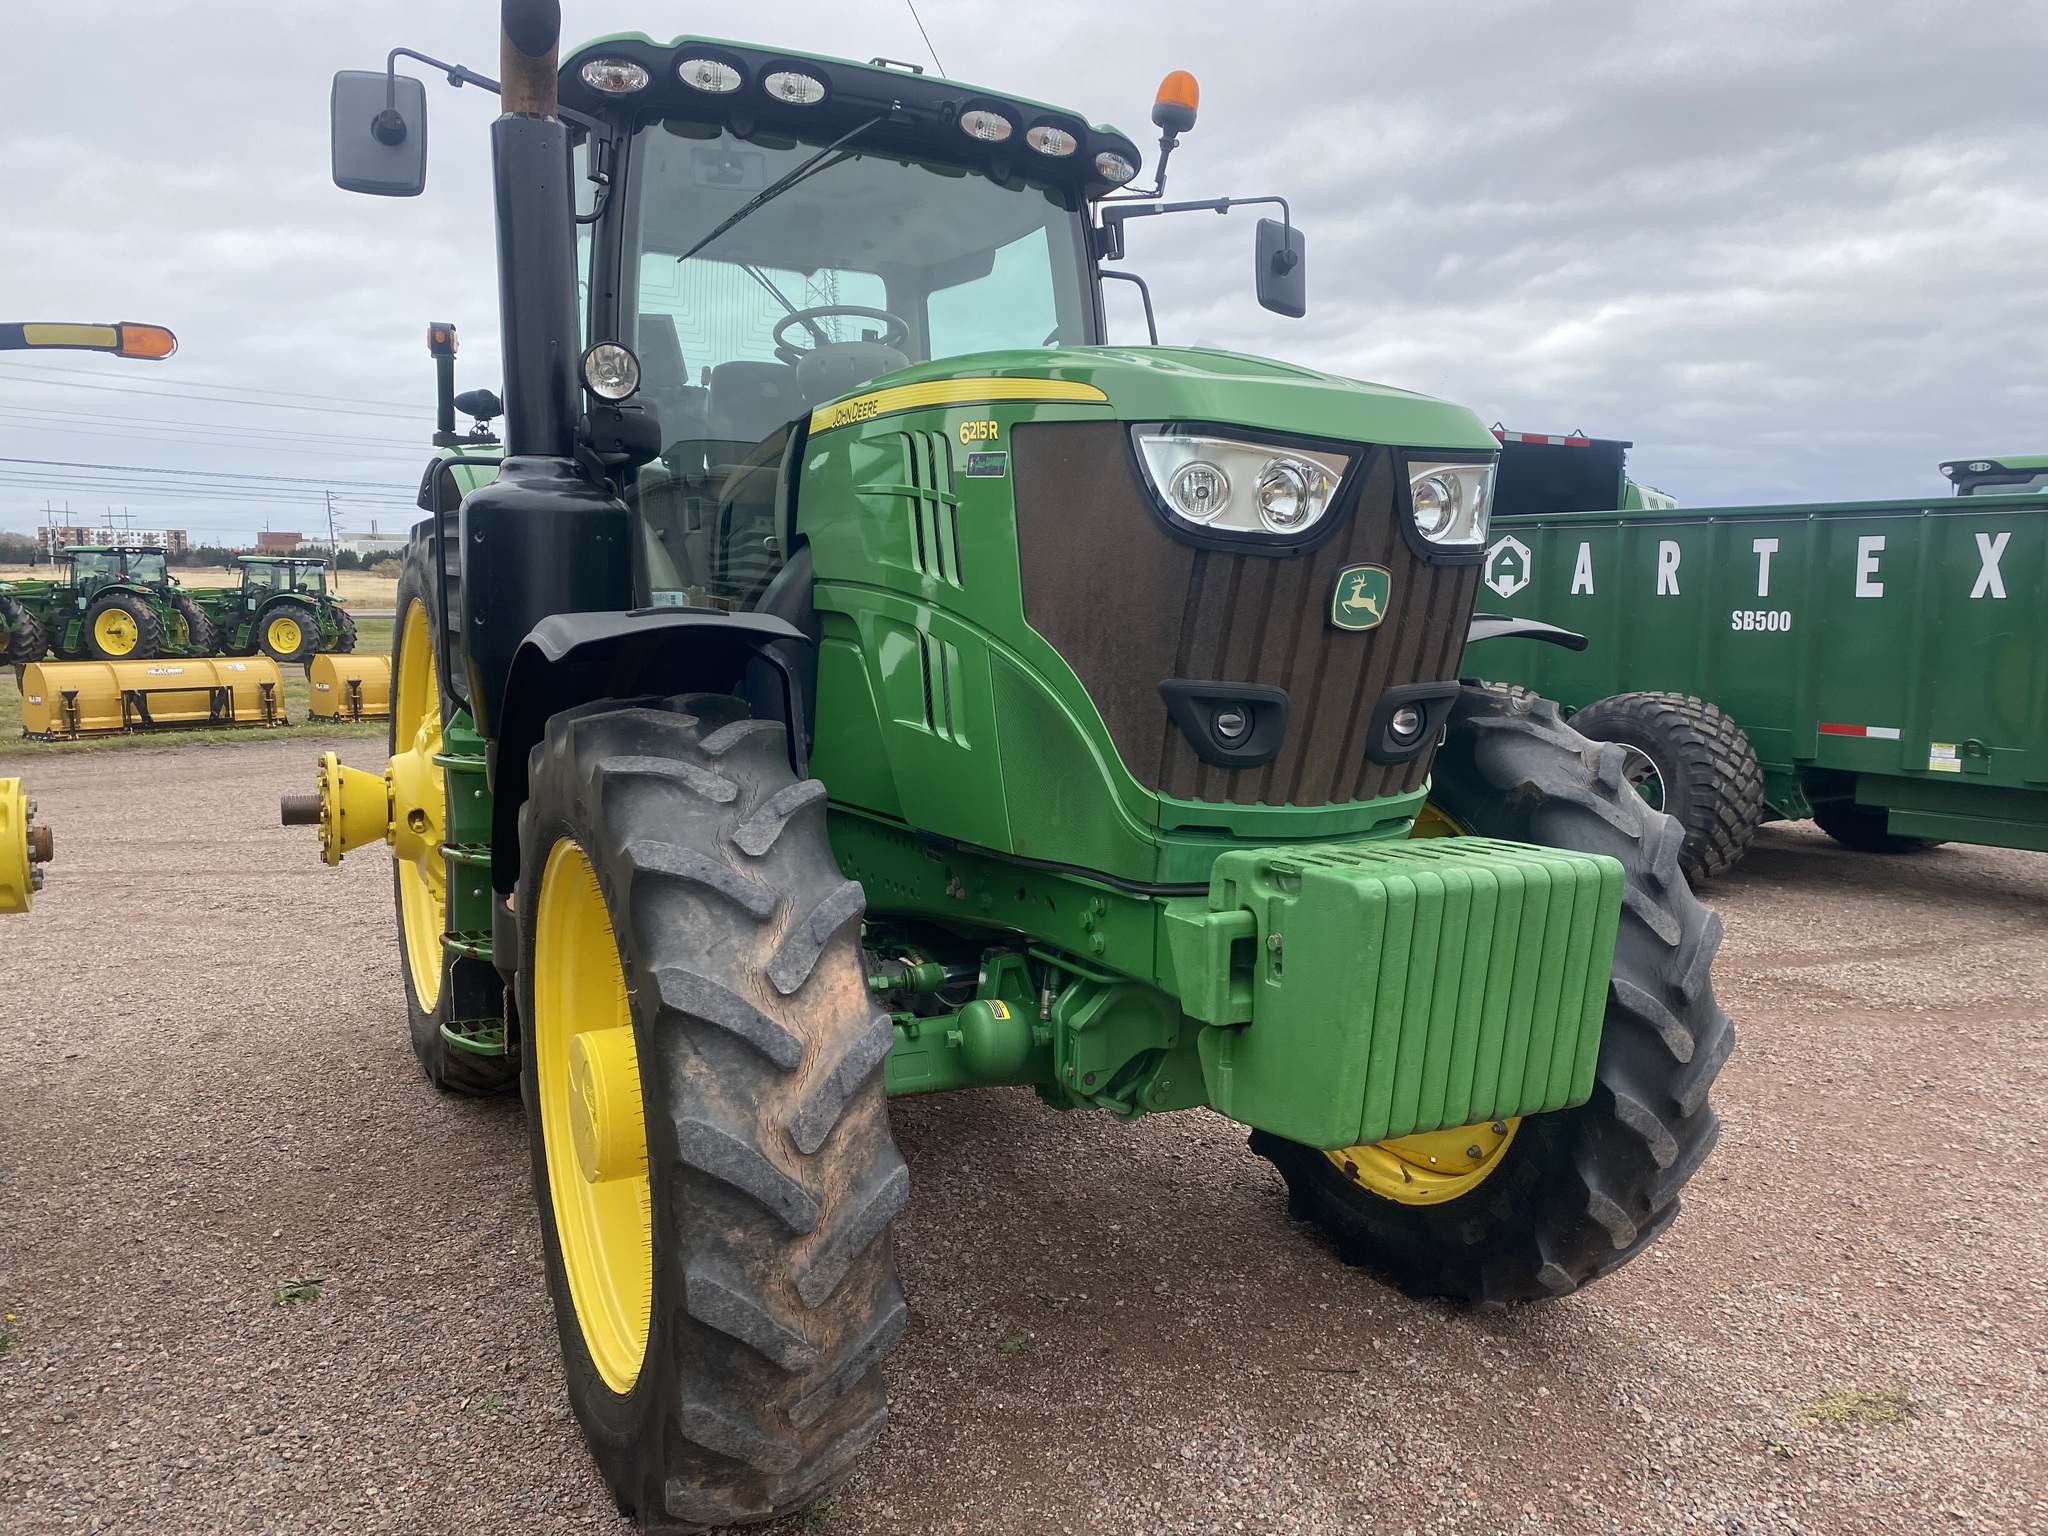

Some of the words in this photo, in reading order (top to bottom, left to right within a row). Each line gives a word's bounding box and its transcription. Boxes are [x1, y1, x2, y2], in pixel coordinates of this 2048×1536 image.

[832, 407, 853, 427] JOHN
[851, 399, 879, 421] DEERE
[1731, 609, 1791, 632] SB500
